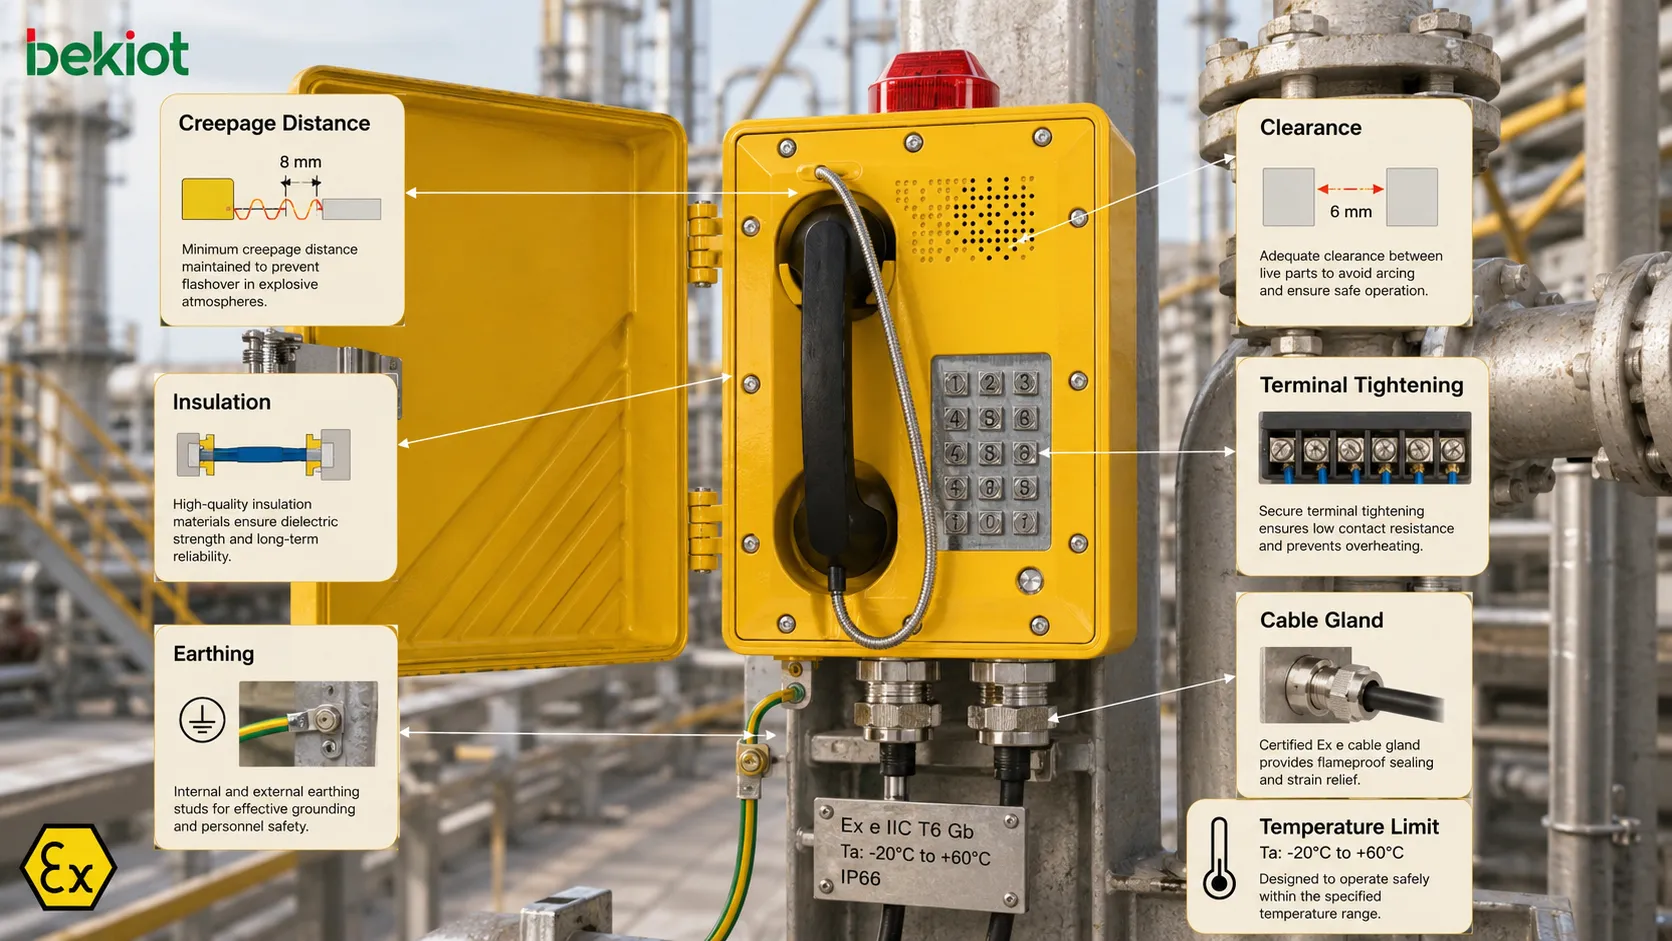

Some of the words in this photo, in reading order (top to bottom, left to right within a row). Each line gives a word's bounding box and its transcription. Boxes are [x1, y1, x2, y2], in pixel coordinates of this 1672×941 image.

[985, 375, 995, 391] 2
[1019, 374, 1030, 391] 3
[950, 410, 960, 427] 4
[841, 817, 863, 834] Ex
[870, 825, 880, 835] e
[887, 820, 911, 836] IIC
[918, 821, 941, 837] T6
[948, 822, 974, 839] Gb
[841, 844, 863, 859] Ta:
[869, 846, 914, 862] -20°C
[920, 849, 935, 863] to
[941, 851, 991, 866] +60°C
[841, 869, 881, 886] IP66
